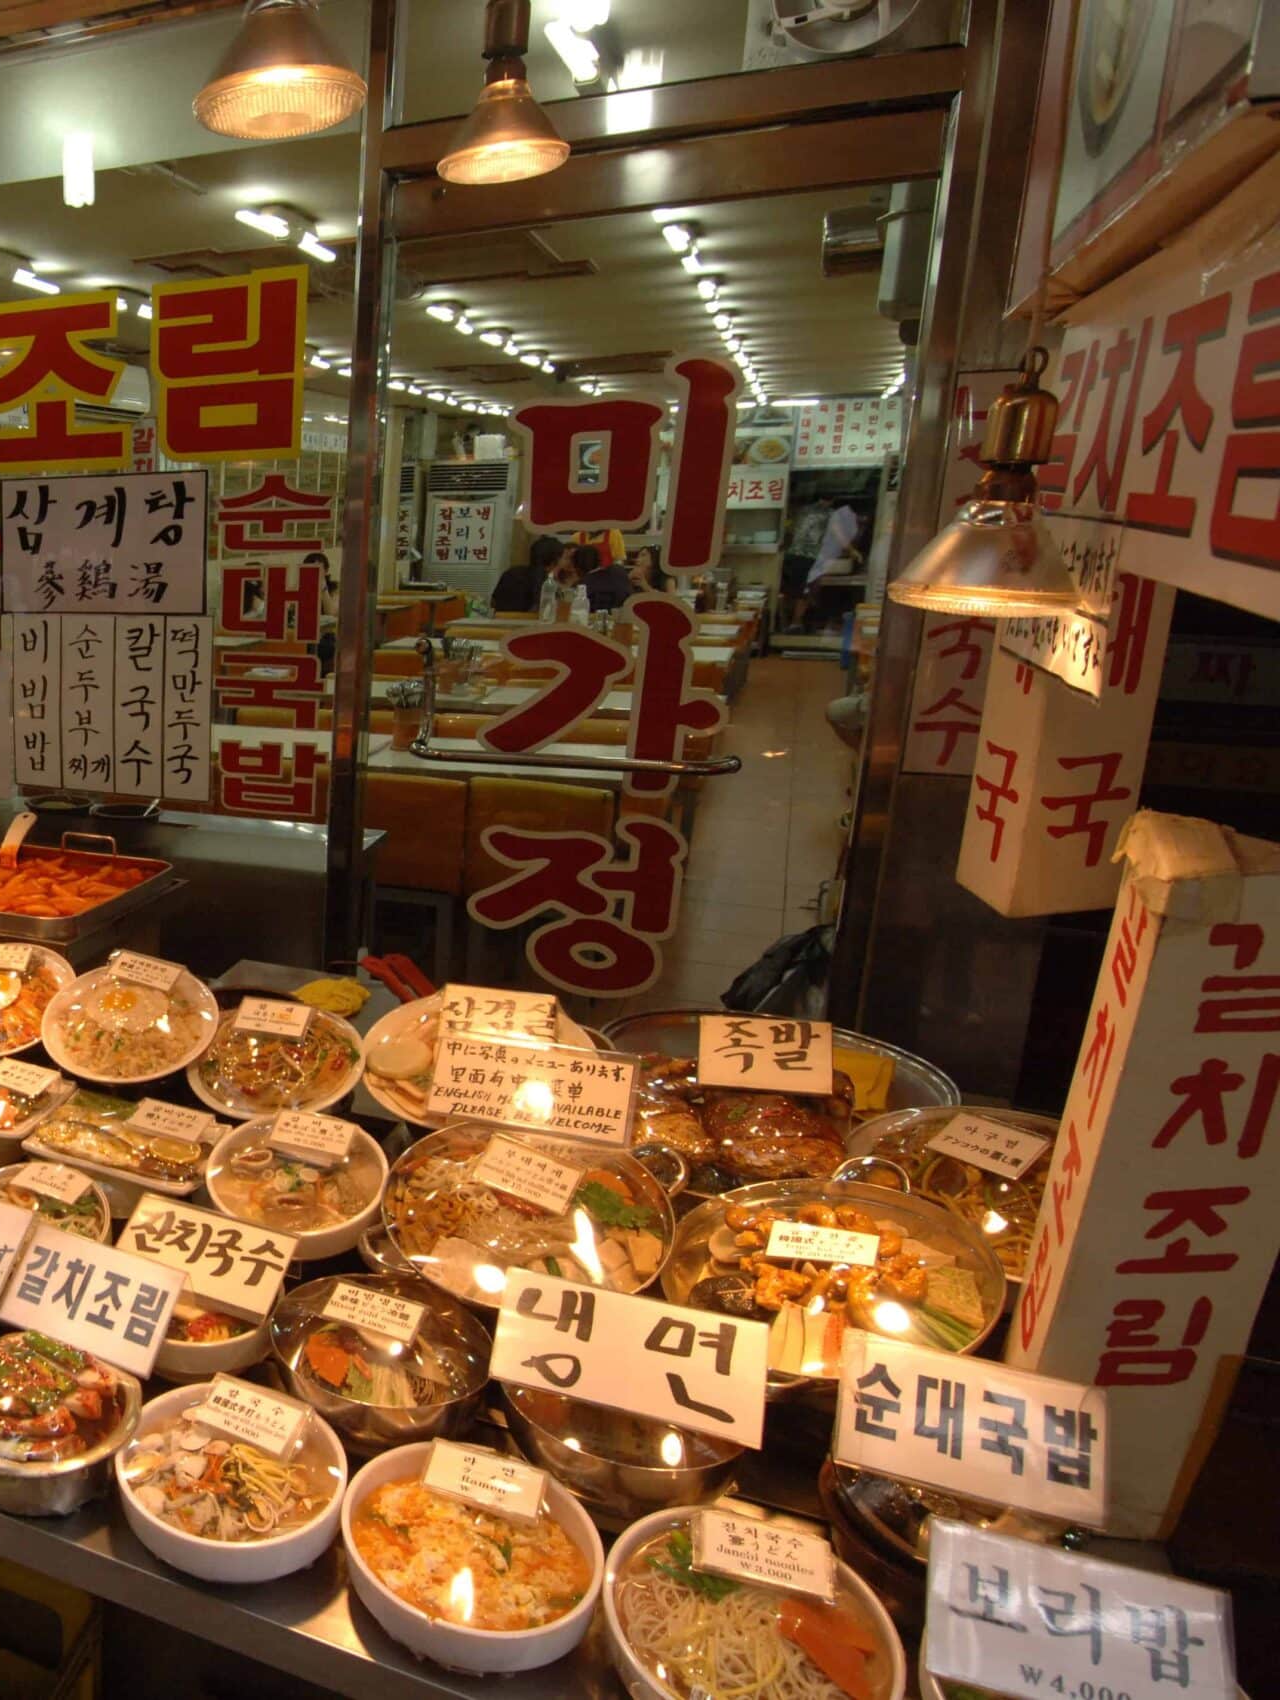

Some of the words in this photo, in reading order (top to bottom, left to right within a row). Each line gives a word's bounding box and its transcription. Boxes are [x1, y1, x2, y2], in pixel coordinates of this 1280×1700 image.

[6, 481, 194, 553] 삼계탕
[20, 622, 51, 772] 비빔밥
[120, 624, 162, 787] 칼국수
[166, 623, 203, 785] 떡만두국
[219, 474, 331, 815] 순대국밥
[713, 1019, 822, 1074] 족발
[552, 1103, 623, 1121] VAILABLE
[16, 1245, 170, 1349] 갈치조림
[130, 1210, 286, 1287] 잔치국수
[516, 1287, 737, 1424] 냉면
[854, 1362, 1098, 1490] 순대국밥
[947, 1560, 1206, 1689] 보리밥
